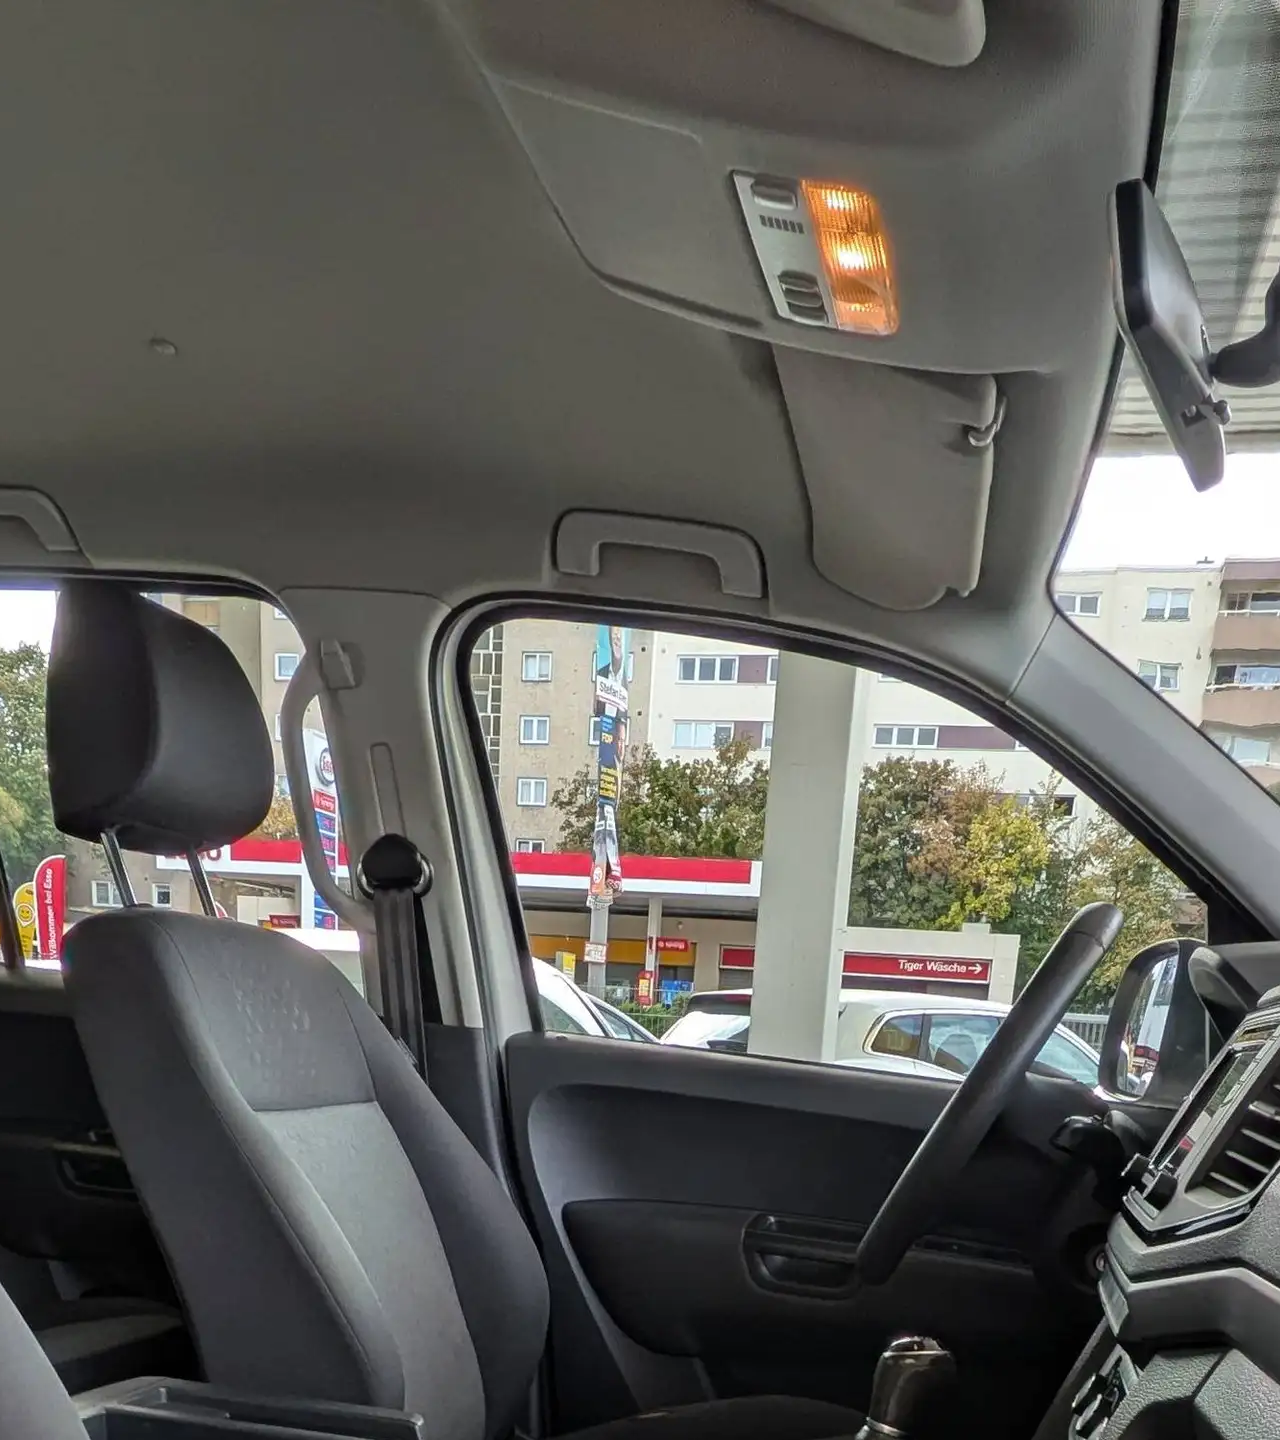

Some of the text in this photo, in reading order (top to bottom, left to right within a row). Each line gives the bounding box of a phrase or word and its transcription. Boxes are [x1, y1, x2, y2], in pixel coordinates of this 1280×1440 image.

[43, 868, 53, 889] Esso
[898, 959, 967, 973] Tiger Wäsche
